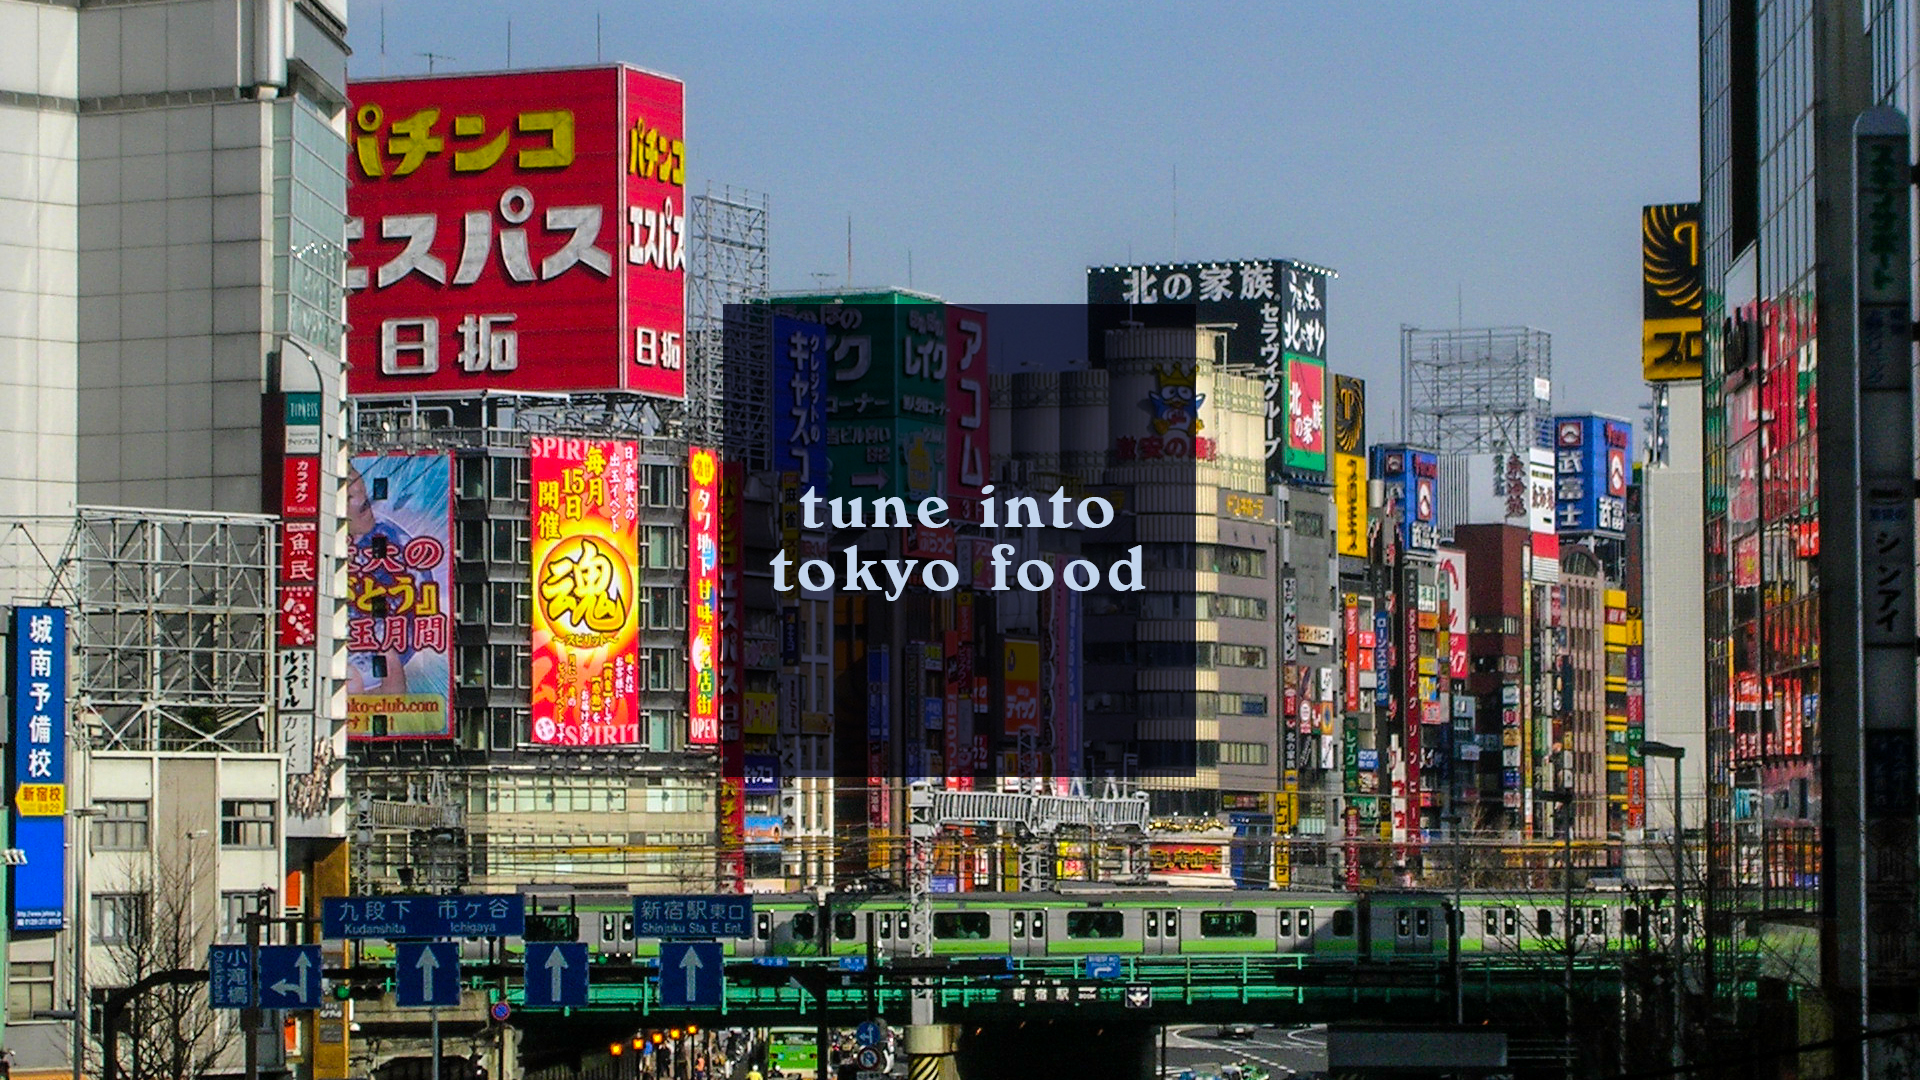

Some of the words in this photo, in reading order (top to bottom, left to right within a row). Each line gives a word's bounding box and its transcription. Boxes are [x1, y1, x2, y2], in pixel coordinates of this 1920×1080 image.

[629, 116, 685, 186] パチンコ
[629, 196, 686, 272] エスパス
[1122, 264, 1275, 304] 北の家族
[381, 312, 519, 375] 日拓
[635, 325, 681, 371] 日拓
[905, 334, 947, 380] レイク
[789, 331, 810, 484] キャスコ
[810, 333, 820, 443] クレジットの
[959, 318, 983, 487] アコム
[1260, 303, 1281, 460] セラヴィグループ
[295, 460, 309, 503] カラオケ
[560, 468, 586, 521] 15日
[583, 444, 608, 507] 毎月
[609, 453, 621, 534] 出玉イベント
[624, 446, 636, 521] 日本最大の
[1558, 450, 1584, 527] 武富士
[538, 481, 562, 541] 開催
[289, 533, 313, 581] 魚民
[541, 538, 627, 633] 魂
[28, 615, 53, 778] 城南予備校
[283, 651, 301, 709] ルノアール
[691, 719, 717, 739] OPEN
[1007, 695, 1037, 720] ディック
[565, 724, 639, 746] SPIRIT
[1346, 731, 1357, 766] レイク
[23, 786, 61, 802] 新宿校
[338, 900, 412, 922] 九段下
[344, 923, 406, 935] Kudanshita
[450, 921, 496, 934] Ichigaya
[641, 900, 745, 921] 新宿駅東口
[641, 922, 686, 934] Shinjuku
[227, 951, 248, 1004] 小滝橋
[1013, 987, 1070, 1001] 新宿駅
